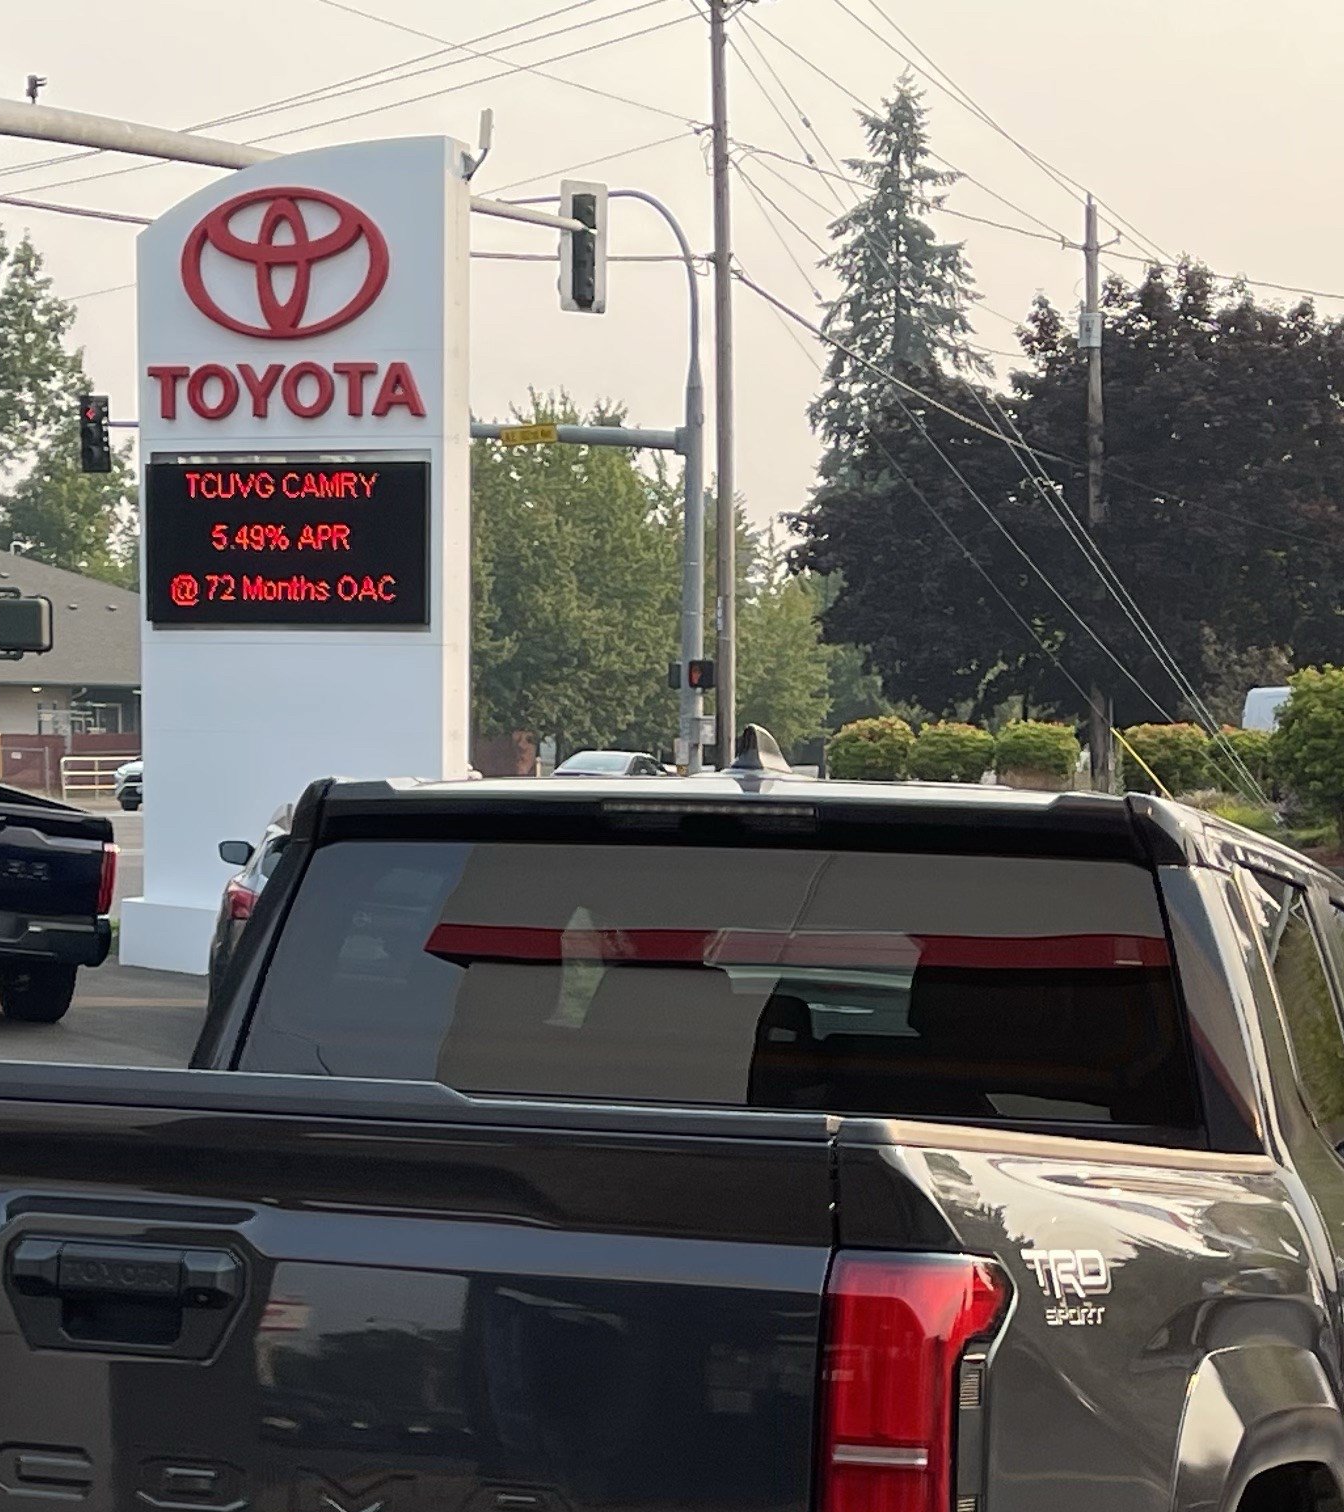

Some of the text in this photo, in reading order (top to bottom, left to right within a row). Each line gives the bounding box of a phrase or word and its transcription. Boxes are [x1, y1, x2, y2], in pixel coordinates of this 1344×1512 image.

[147, 361, 427, 420] TOYOTA
[186, 472, 380, 499] TCUVG CAMRY
[211, 524, 351, 551] 5.49% APR
[171, 574, 397, 606] @ 72 Months OAC
[1020, 1249, 1108, 1298] TRD
[1046, 1306, 1105, 1325] SPORT
